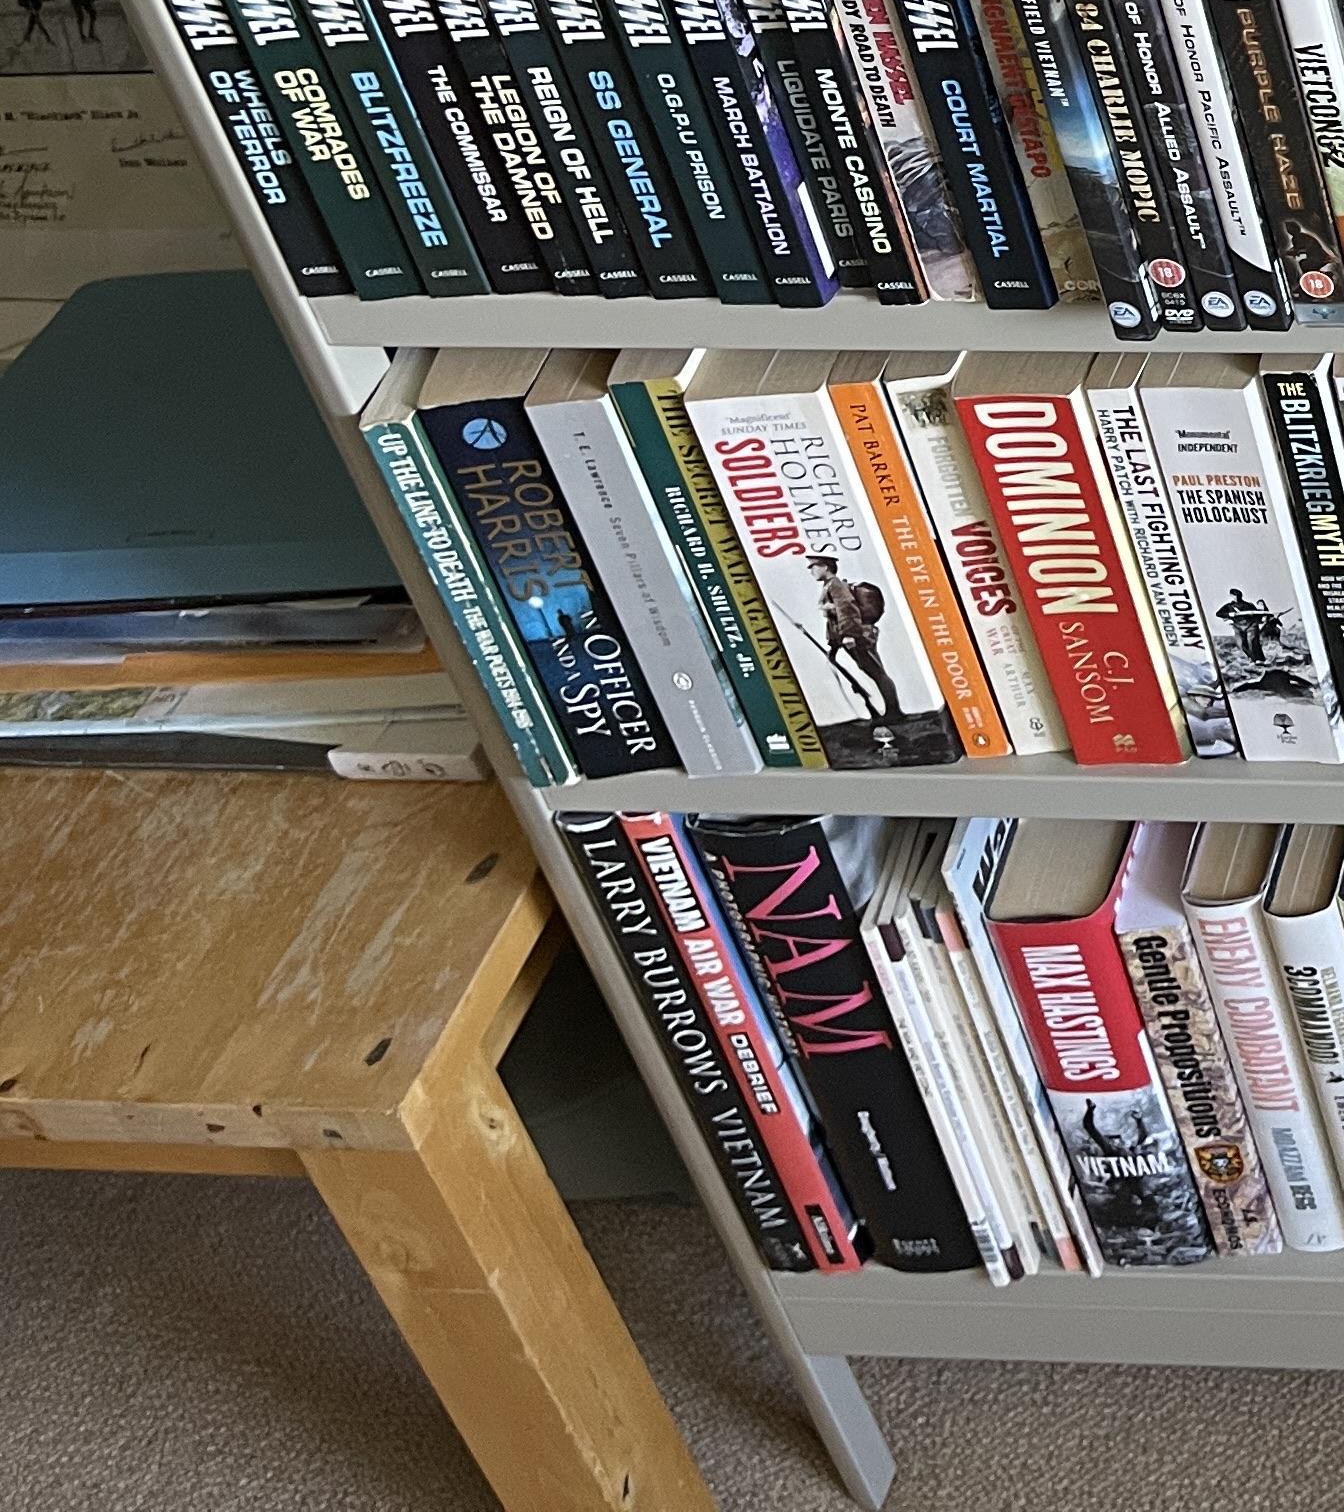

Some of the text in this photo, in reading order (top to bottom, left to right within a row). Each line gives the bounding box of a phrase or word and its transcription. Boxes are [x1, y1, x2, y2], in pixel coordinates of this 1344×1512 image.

[352, 72, 448, 248] BLITZFREEZE
[715, 438, 806, 559] SOLDIERS
[771, 438, 838, 556] HOLMES
[802, 436, 862, 553] RICHARD
[1172, 474, 1262, 488] PAUL PRESTON
[1178, 443, 1238, 453] INDEPENDENT
[1178, 490, 1266, 507] THE SPANISH
[458, 463, 549, 603] HARRIS
[502, 459, 595, 590] ROBERT
[974, 402, 1118, 616] DOMINION
[1182, 506, 1268, 526] HOLOCAUST
[1059, 620, 1114, 724] SANSOM
[722, 846, 892, 1059] NAM
[582, 839, 786, 1230] LARRY BURROWS VIETNAM
[1020, 944, 1120, 1082] MAX HASTINGS
[1076, 1154, 1168, 1178] VIETNAM
